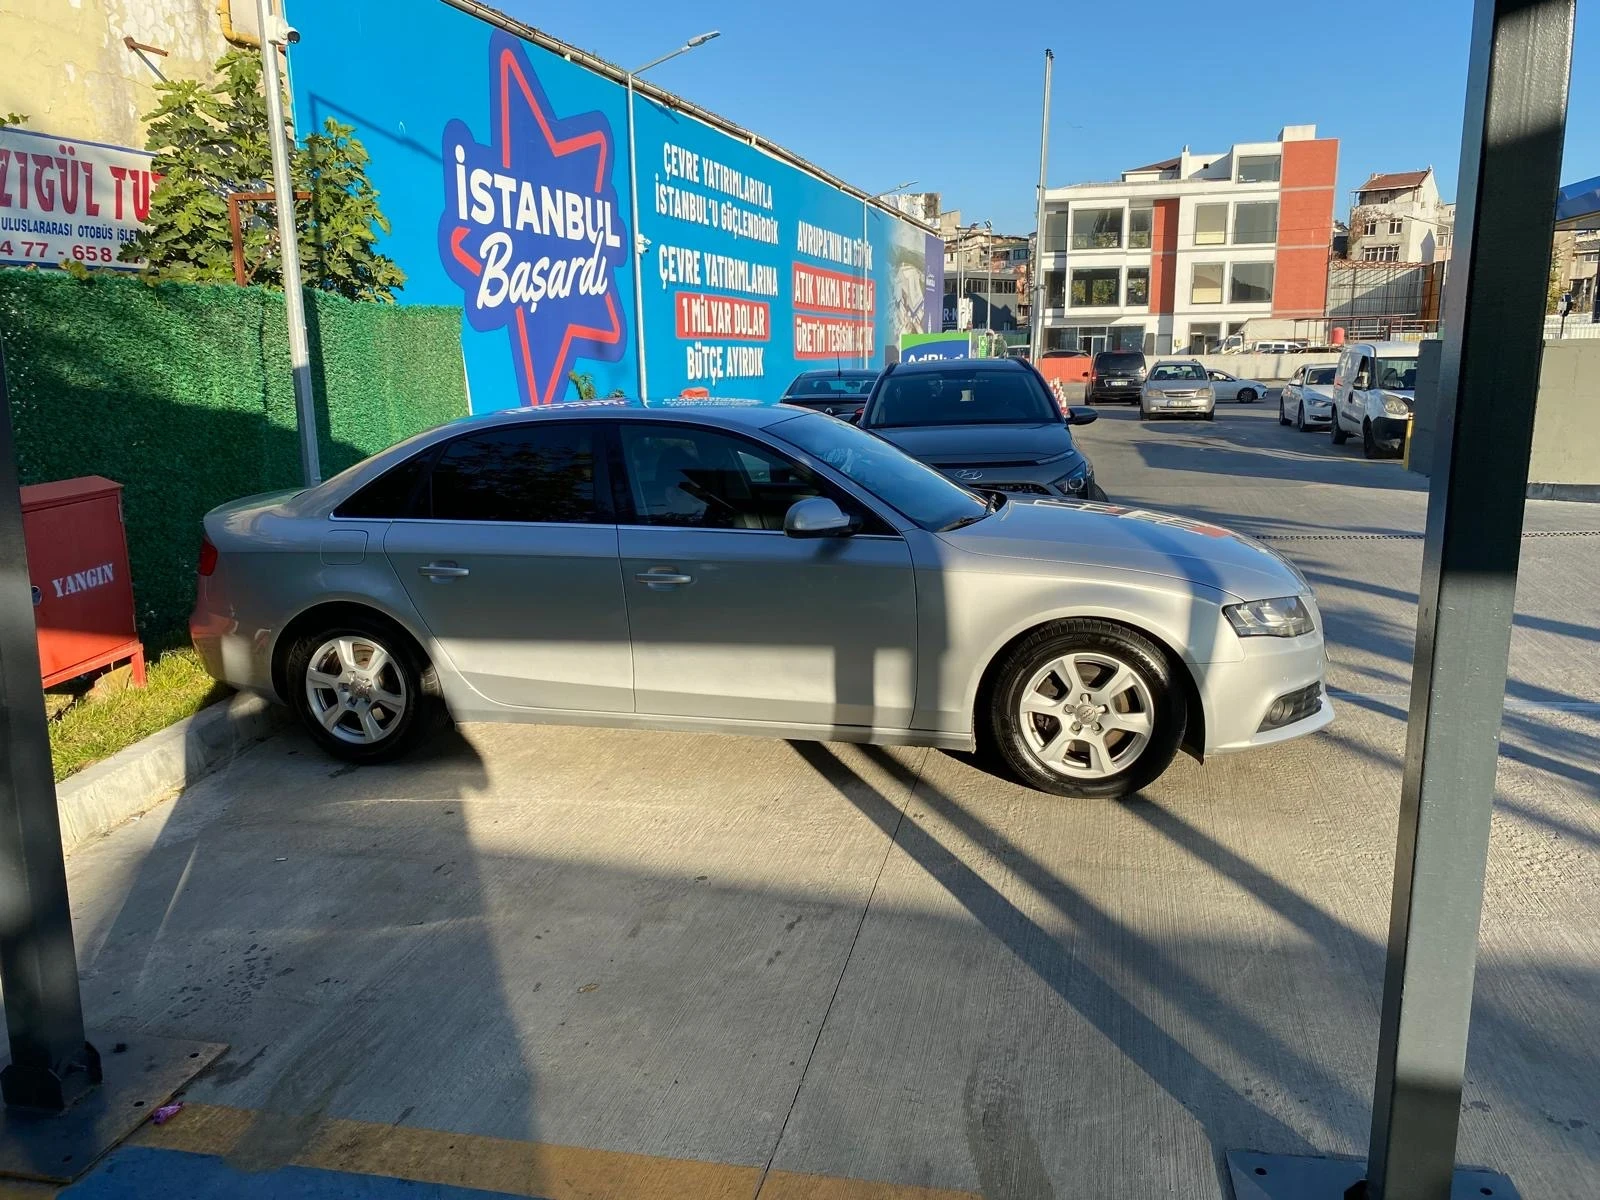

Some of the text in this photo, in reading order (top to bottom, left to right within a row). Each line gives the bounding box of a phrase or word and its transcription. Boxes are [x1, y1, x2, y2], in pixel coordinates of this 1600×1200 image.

[109, 166, 167, 222] TU
[455, 144, 621, 248] İSTANBUL
[663, 142, 773, 210] ÇEVRE YATIRIMLARIYLA
[1, 217, 73, 237] ULUSLARARASI
[78, 224, 113, 241] OTOBÜS
[655, 172, 779, 245] İSTANBUL'U GÜÇLENDİRDİK
[72, 245, 113, 262] 658
[797, 220, 842, 263] AVRUPA'NIN
[843, 236, 852, 266] EN
[476, 230, 608, 313] Başardı
[659, 244, 779, 296] ÇEVRE YATIRIMLARINA
[795, 271, 815, 305] ATIK
[816, 276, 841, 308] YAKMA
[842, 281, 851, 309] VE
[682, 294, 765, 336] 1 MİLYAR DOLAR
[796, 317, 873, 358] ÜRETİM TESİSİNİ AÇIK
[686, 341, 764, 387] BÜTÇE AYIRDIK
[908, 354, 961, 362] AdBl
[51, 563, 114, 598] YANGIN
